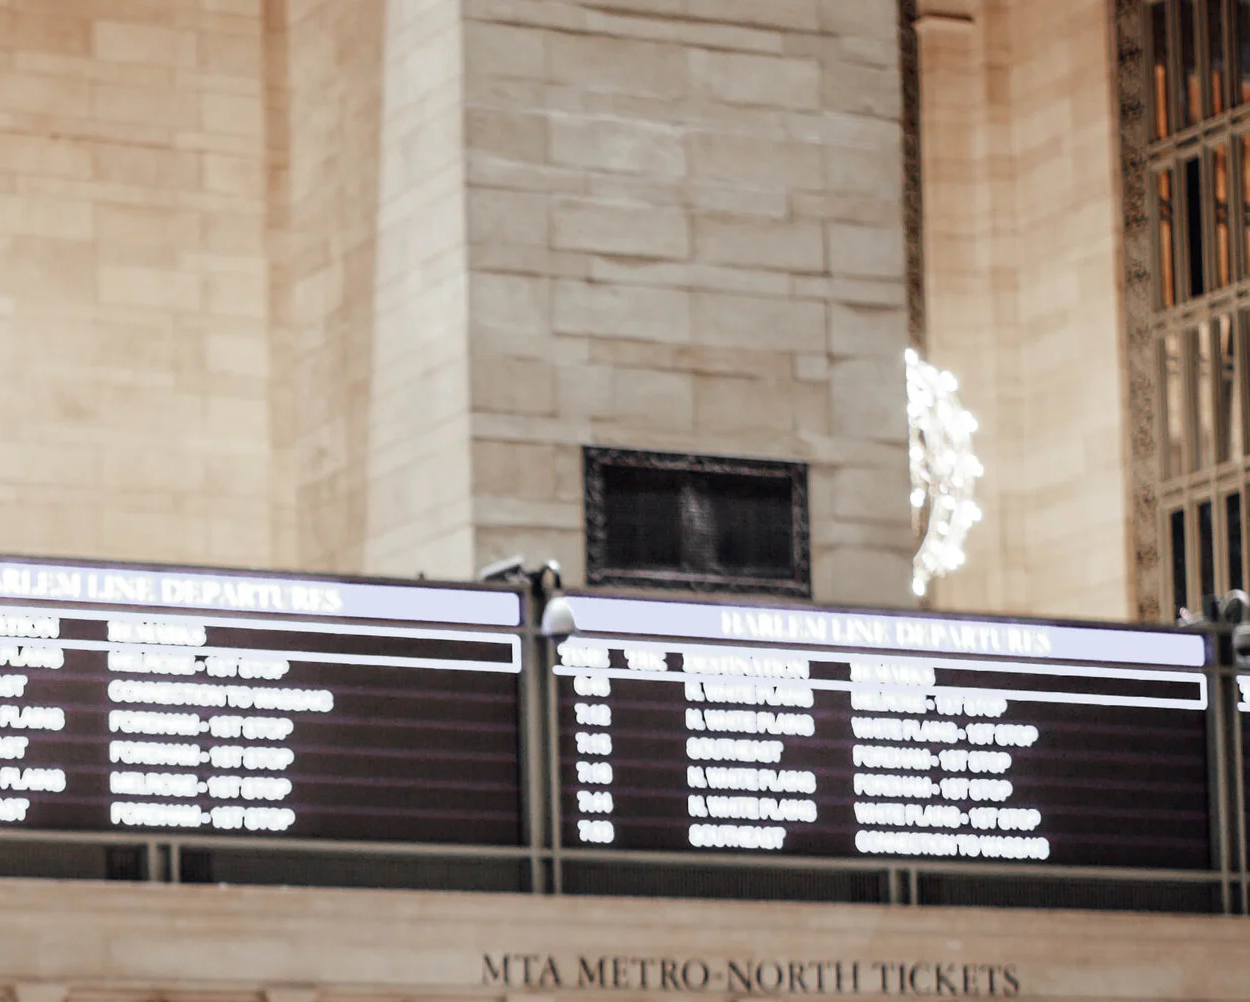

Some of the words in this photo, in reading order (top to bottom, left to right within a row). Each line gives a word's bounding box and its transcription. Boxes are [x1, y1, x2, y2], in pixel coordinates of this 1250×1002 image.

[87, 572, 155, 604] LINE
[161, 576, 343, 612] DEPARTURES
[720, 611, 828, 642] HARLEM
[831, 617, 888, 646] LINE
[895, 620, 1052, 656] DEPARTURES
[482, 953, 561, 987] MTA
[577, 954, 860, 996] METRO-NORTH
[871, 960, 1020, 997] TICKETS
